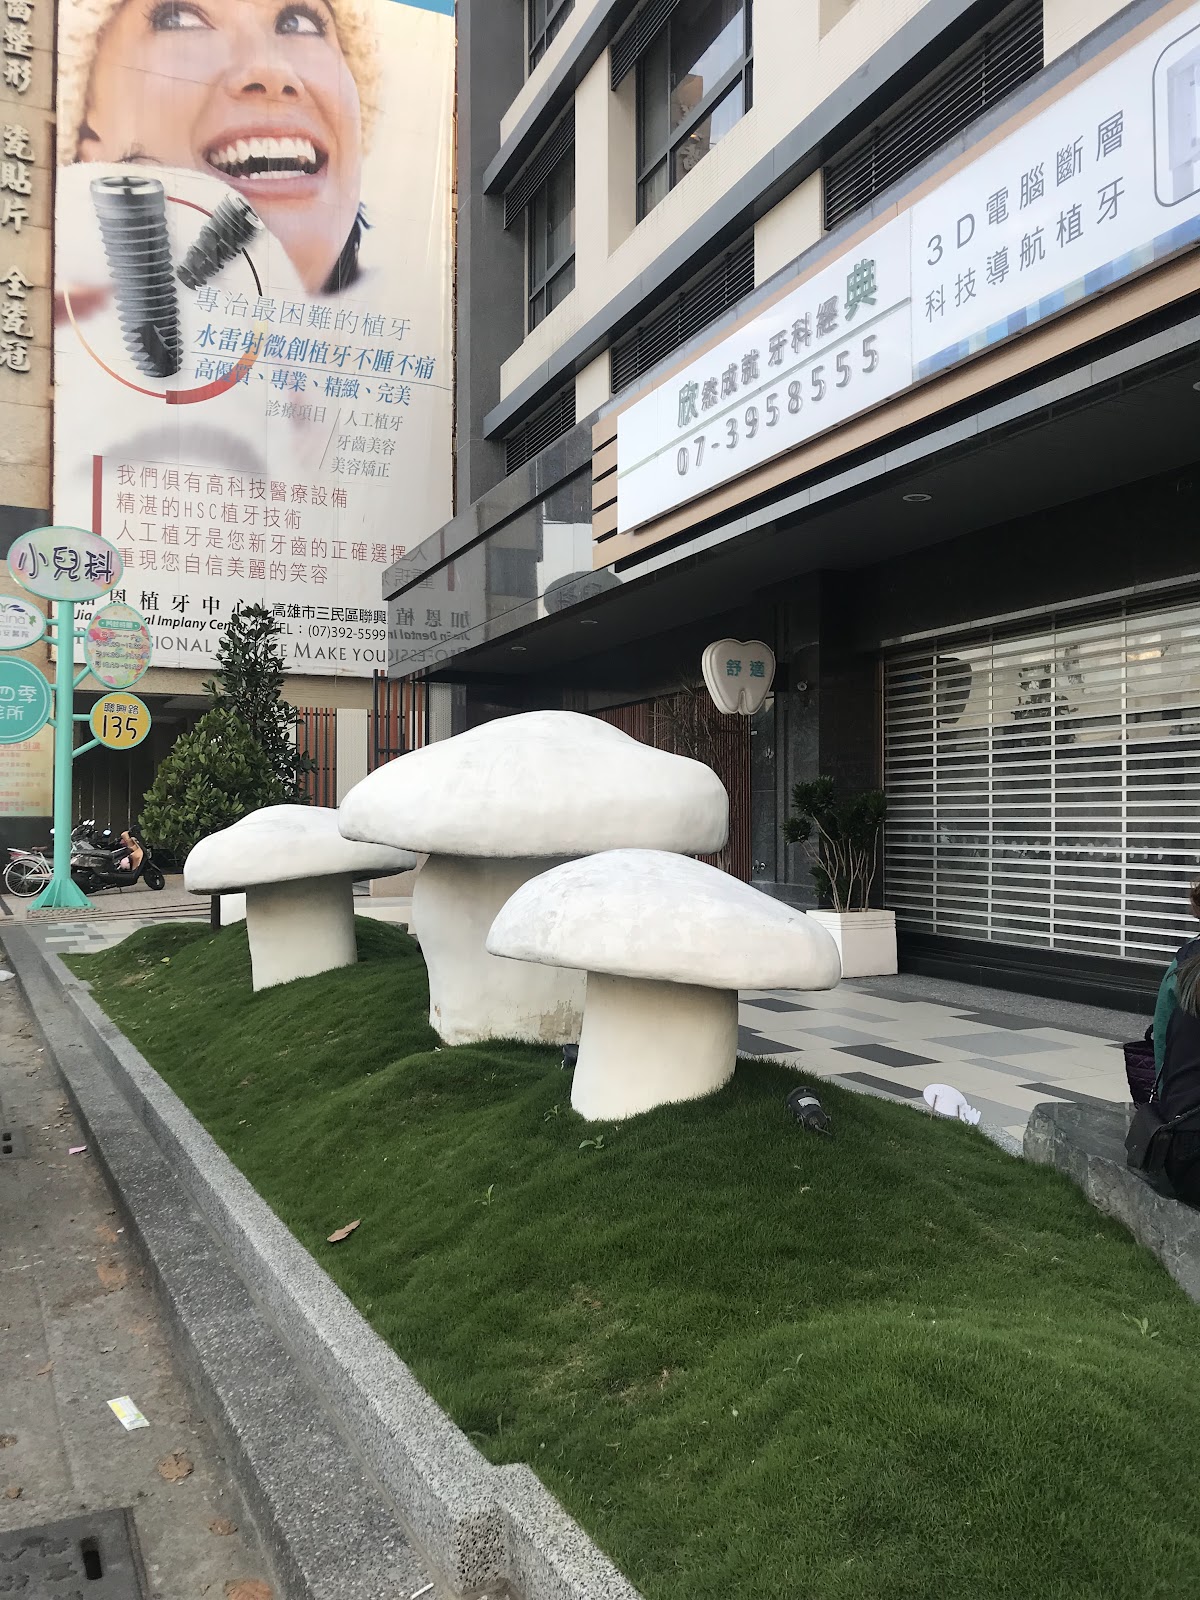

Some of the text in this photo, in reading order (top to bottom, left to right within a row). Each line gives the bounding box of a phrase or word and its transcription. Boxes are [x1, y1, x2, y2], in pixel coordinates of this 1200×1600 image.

[1, 124, 34, 233] 瓷貼片
[927, 110, 1125, 266] 3D電腦斷層
[925, 176, 1126, 324] 科技導航植牙
[0, 265, 33, 374] 全瓷冠
[195, 284, 412, 342] 專治最困難的植牙
[194, 323, 437, 381] 水雷射微創植牙不腫不痛
[343, 410, 404, 432] 人工植牙
[676, 334, 881, 477] 07-3958555
[336, 434, 397, 456] 牙齒美容
[116, 464, 348, 509] 我們俱有高科技醫療設備
[330, 456, 391, 479] 美容矯正
[116, 491, 302, 531] 精湛的HSC植牙技術
[17, 541, 115, 584] 小兒科
[117, 547, 328, 585] 重現您自信美麗的笑容
[294, 642, 347, 661] MAKE
[308, 625, 386, 641] (07)392-5599
[726, 659, 764, 678] 舒適
[102, 715, 138, 740] 135
